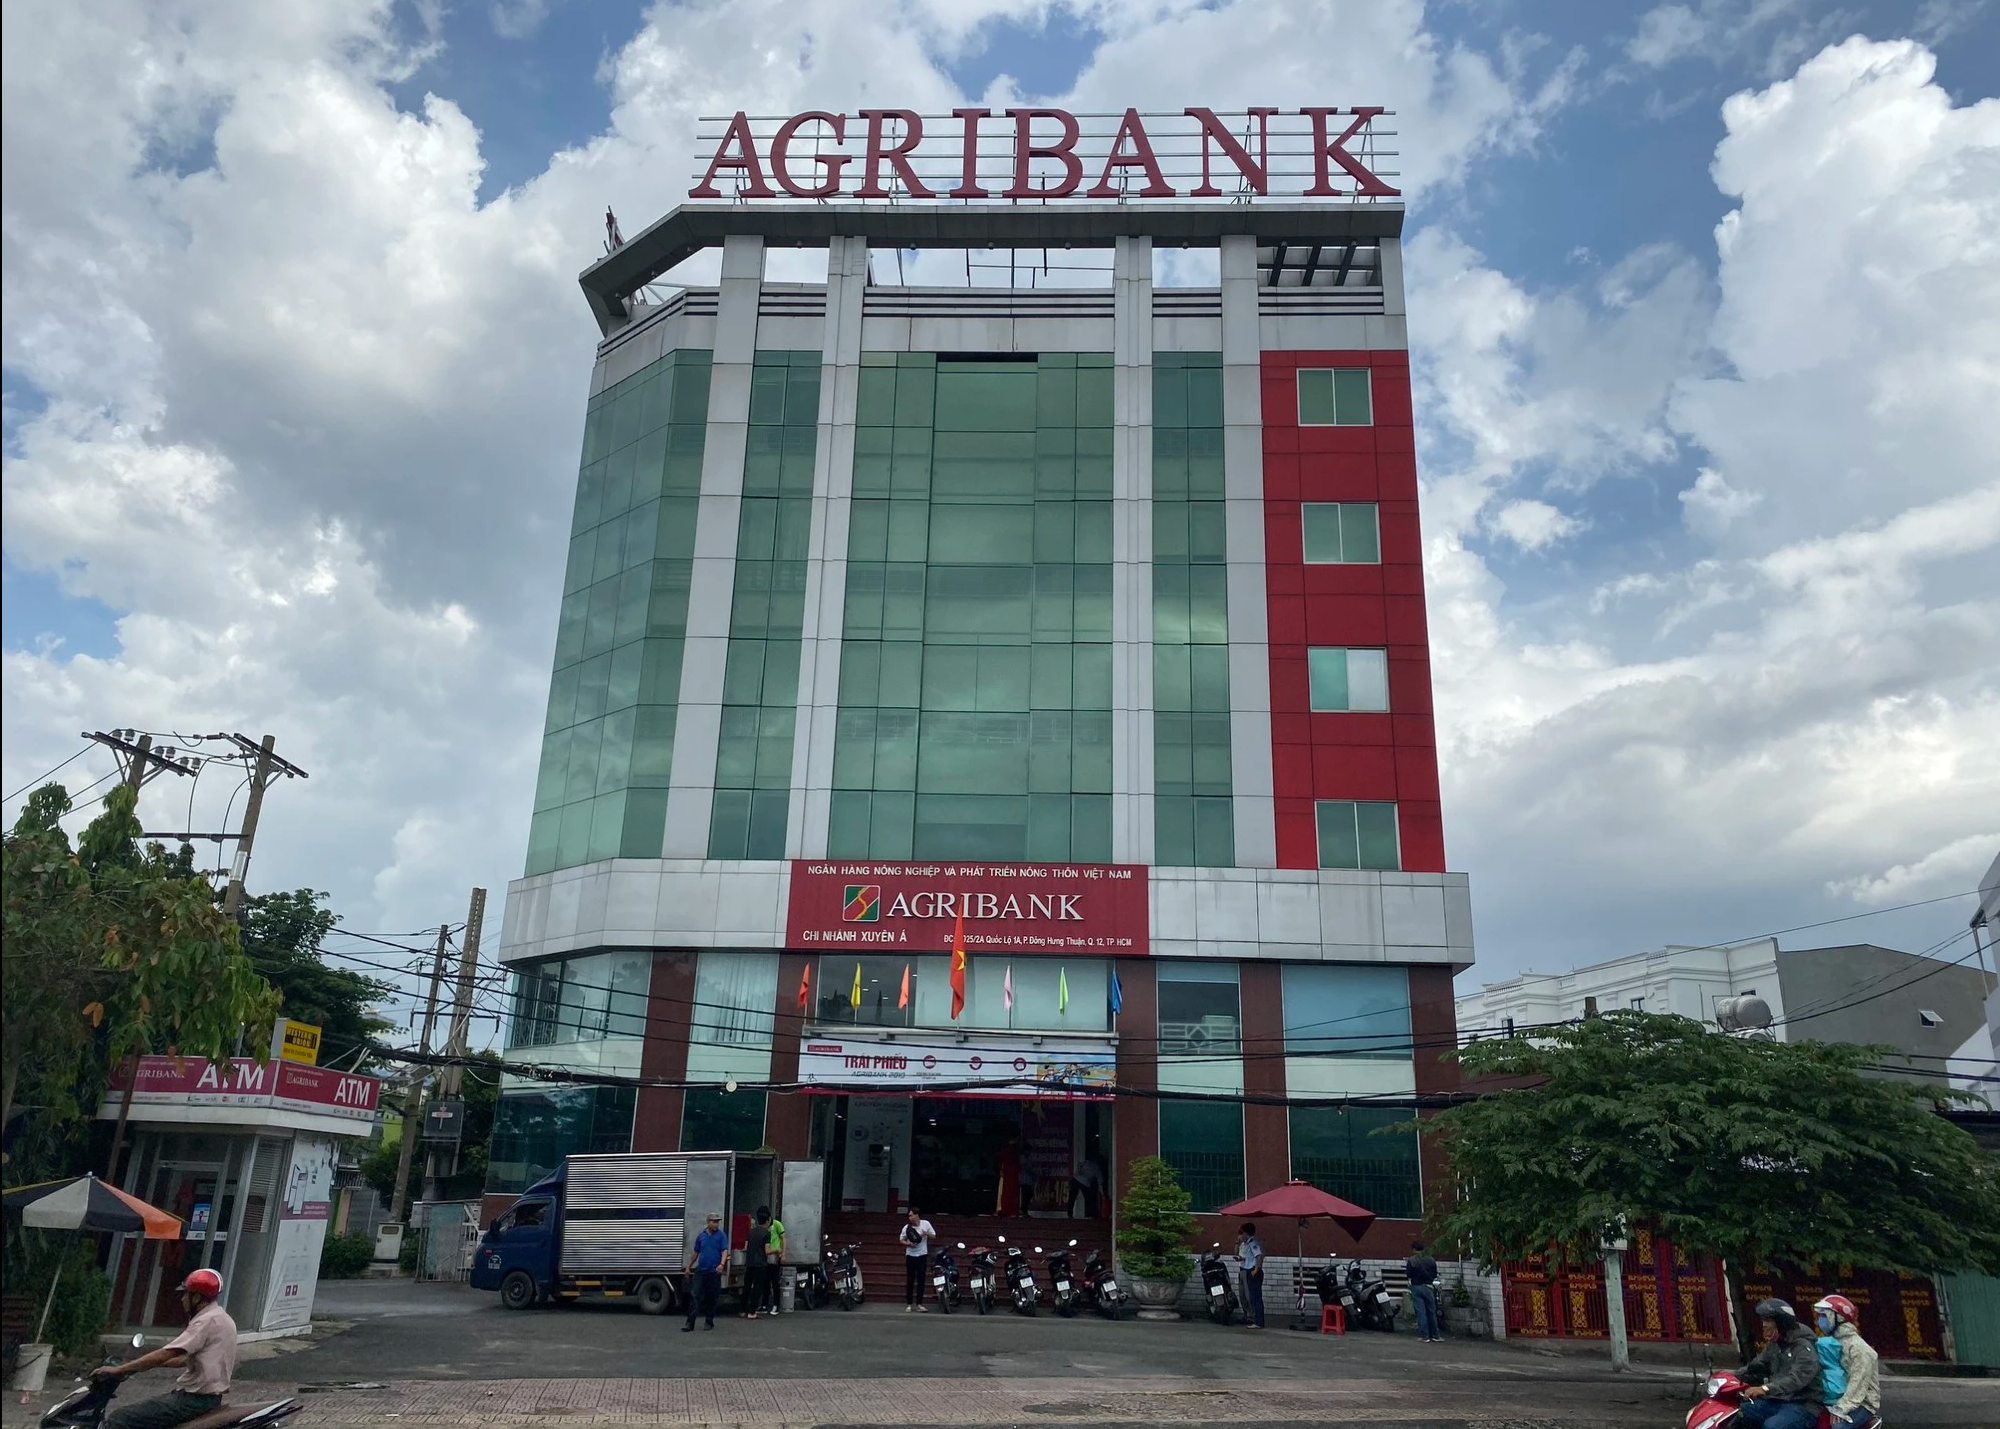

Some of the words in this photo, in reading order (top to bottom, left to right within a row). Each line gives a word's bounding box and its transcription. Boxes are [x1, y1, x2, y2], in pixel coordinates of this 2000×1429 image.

[687, 105, 1402, 198] AGRIBANK
[808, 865, 837, 875] NGÂN
[841, 864, 870, 875] HÀNG
[874, 865, 902, 876] NÔNG
[905, 865, 940, 877] NGHIỆP
[944, 866, 956, 876] VÀ
[960, 865, 985, 877] PHÁT
[1019, 866, 1047, 878] NÔNG
[1052, 866, 1079, 878] THÔN
[1083, 867, 1104, 880] VIỆT
[1108, 869, 1132, 879] NAM
[885, 892, 1084, 920] AGRIBANK
[803, 930, 819, 941] CHI
[822, 929, 857, 941] NHÁNH
[861, 929, 895, 942] XUYÊN
[899, 929, 907, 942] Á
[985, 934, 1003, 944] Quốc
[1003, 936, 1012, 945] Lộ
[1116, 938, 1132, 946] HCM
[293, 1076, 319, 1088] AGRIBANK
[333, 1077, 371, 1106] ATM
